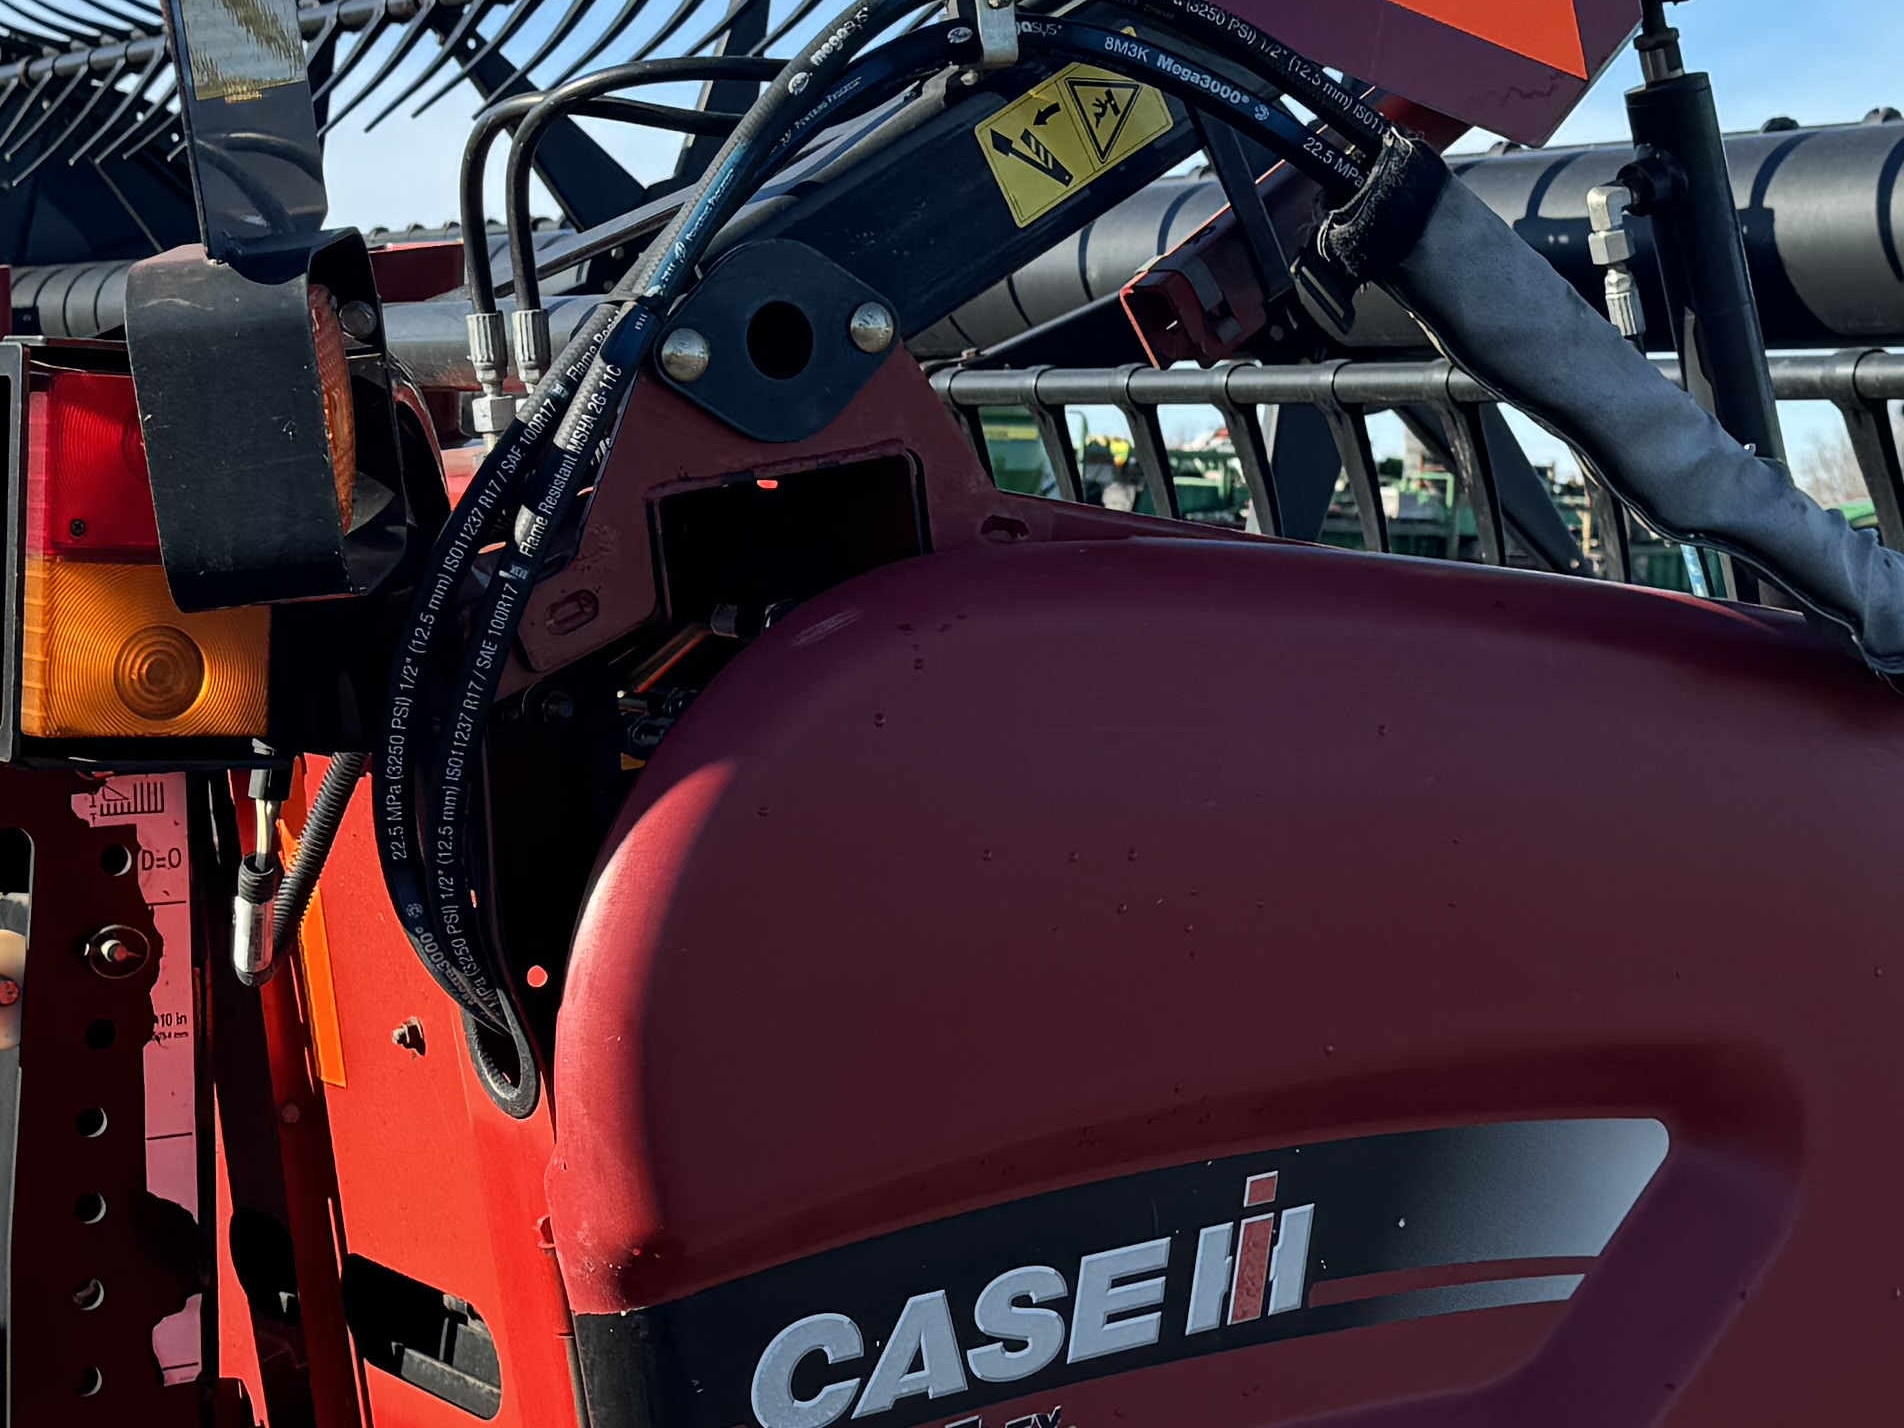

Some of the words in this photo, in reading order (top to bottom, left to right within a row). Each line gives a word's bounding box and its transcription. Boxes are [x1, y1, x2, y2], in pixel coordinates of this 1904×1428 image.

[1227, 18, 1257, 45] PSI)
[1288, 55, 1322, 86] (12.5
[1322, 82, 1354, 111] mm)
[1104, 35, 1150, 63] 8M3K
[1303, 136, 1333, 164] 22.5
[1334, 156, 1365, 189] MPa
[587, 363, 622, 414] 2G-11C
[519, 398, 557, 447] 100R17
[566, 413, 598, 455] MSHA
[478, 481, 497, 510] R17
[538, 452, 580, 515] Resistant
[519, 514, 549, 558] Flame
[428, 572, 454, 611] mm)
[490, 582, 519, 637] 100R17
[407, 612, 435, 654] (12.5
[399, 657, 419, 691] 1/2"
[476, 638, 498, 671] SAE
[391, 696, 413, 730] PSI)
[462, 680, 484, 711] R17
[385, 735, 405, 780] (3250
[386, 784, 403, 821] MPa
[442, 785, 462, 821] mm)
[389, 825, 407, 860] 22.5
[436, 825, 454, 864] (12.5
[441, 905, 463, 934] PSI)
[451, 937, 481, 977] (3250
